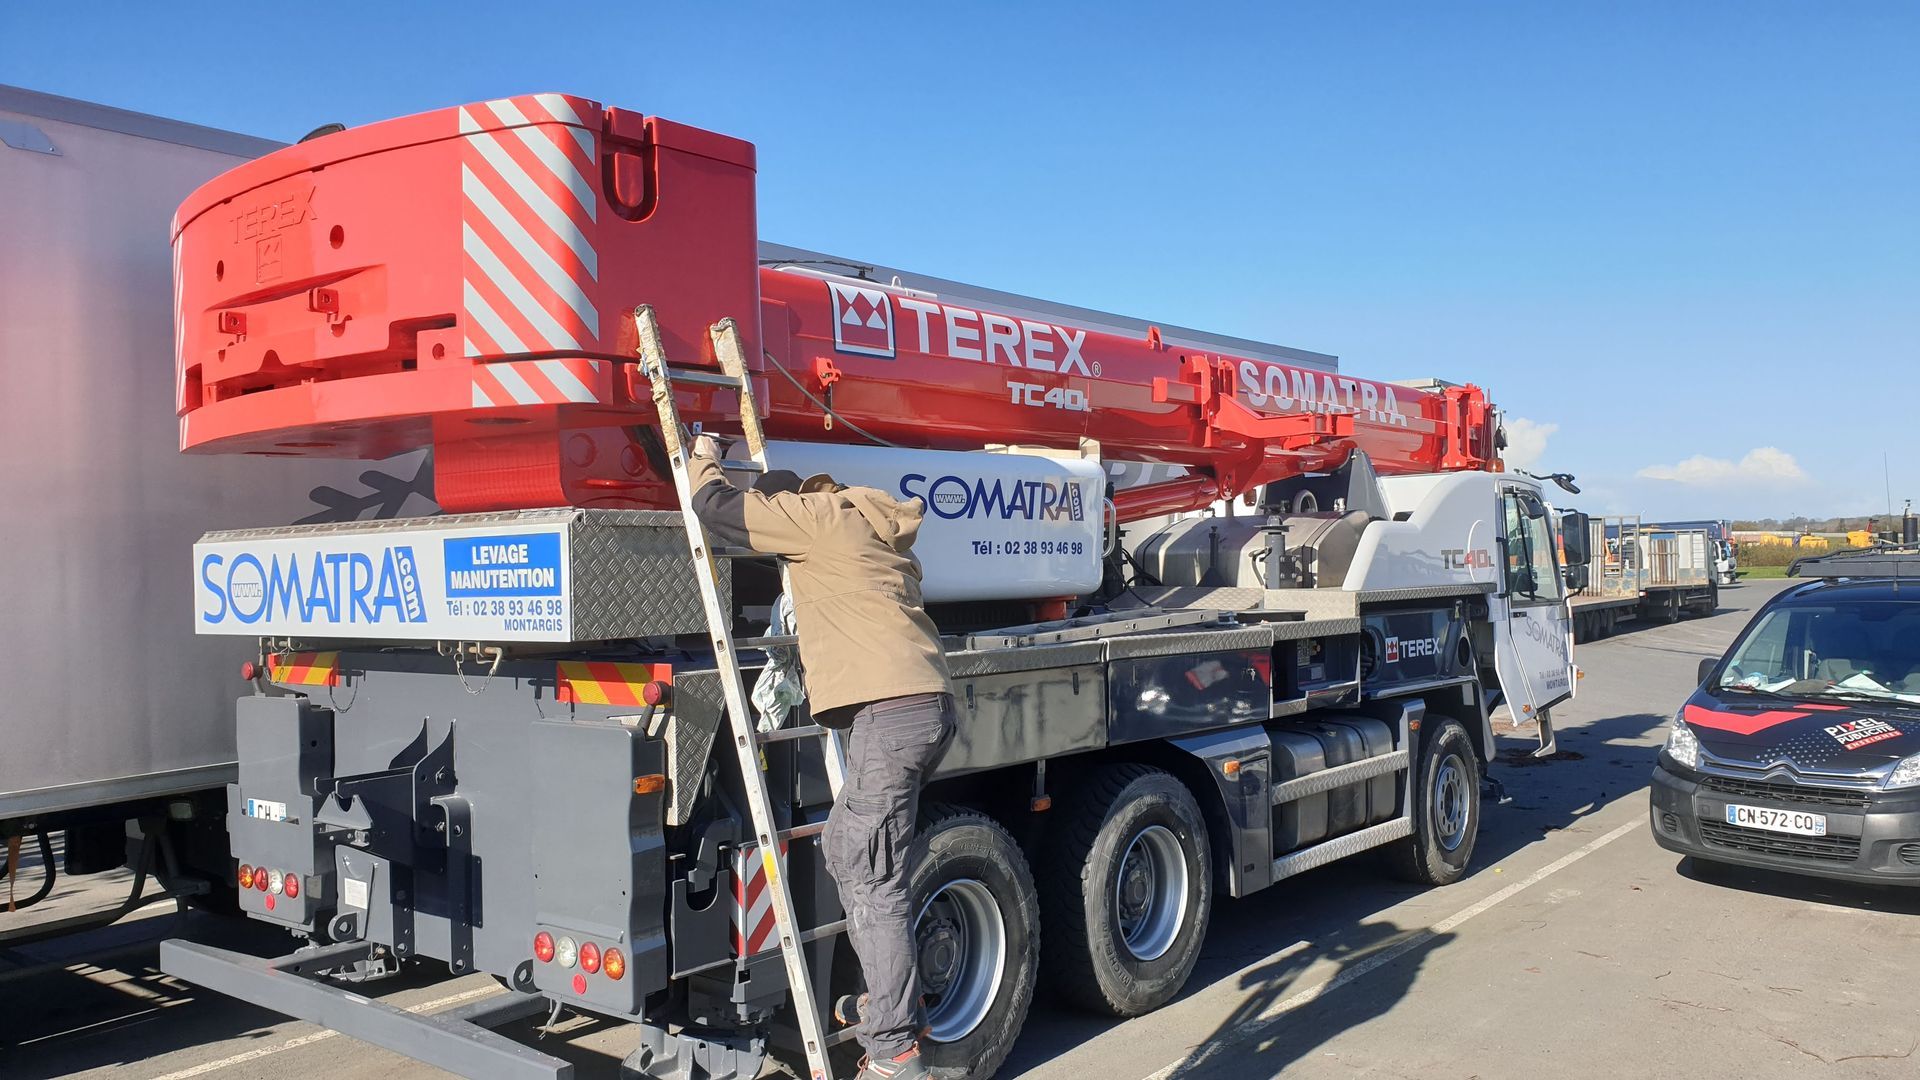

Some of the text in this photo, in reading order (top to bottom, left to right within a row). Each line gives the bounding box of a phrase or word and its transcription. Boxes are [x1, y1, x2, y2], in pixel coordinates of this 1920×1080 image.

[229, 186, 318, 244] TEREX
[897, 296, 1092, 377] TEREX
[1239, 360, 1408, 427] SOMATRA
[899, 473, 1074, 522] SOMATRA
[471, 543, 529, 566] LEVAGE
[971, 540, 992, 555] Tél
[1004, 541, 1020, 555] 02
[1023, 541, 1038, 555] 38
[1040, 541, 1054, 555] 93
[1056, 541, 1069, 555] 46
[1070, 541, 1083, 555] 98
[201, 547, 408, 625] SOMATRA
[450, 567, 555, 590] MANUTENTION
[446, 600, 463, 616] Tél
[473, 600, 488, 616] 02
[490, 600, 505, 616] 38
[508, 600, 524, 616] 93
[527, 600, 543, 616] 46
[546, 600, 562, 616] 98
[504, 618, 563, 632] MONTARGIS
[1399, 637, 1441, 659] TEREX
[1823, 717, 1886, 737] PIXEL
